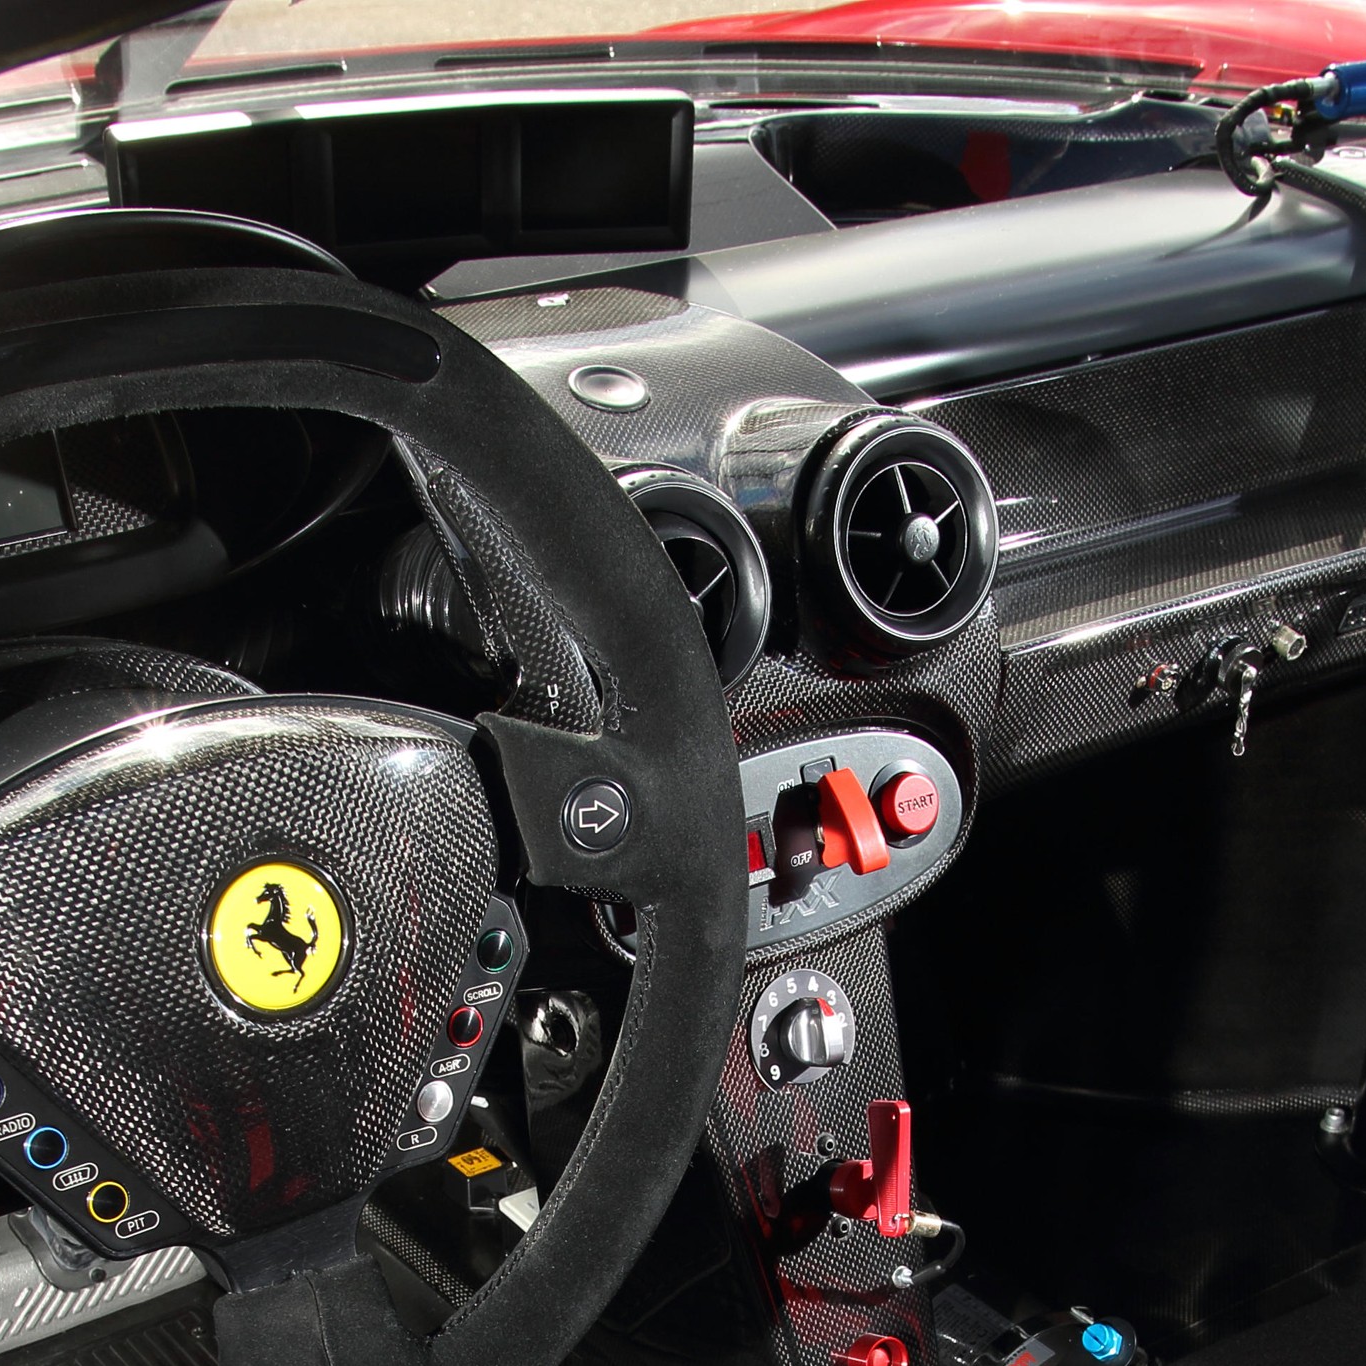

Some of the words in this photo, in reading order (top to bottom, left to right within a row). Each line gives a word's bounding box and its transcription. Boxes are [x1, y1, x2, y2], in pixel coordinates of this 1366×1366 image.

[547, 683, 560, 715] UP
[777, 778, 794, 793] ON
[898, 793, 934, 815] START
[791, 850, 812, 867] OFF
[786, 977, 797, 994] 5
[808, 976, 819, 992] 4
[467, 986, 500, 1002] SCROLL
[768, 992, 778, 1007] 6
[826, 990, 837, 1005] 3
[758, 1015, 768, 1032] 7
[760, 1042, 770, 1057] 8
[770, 1065, 781, 1081] 9
[411, 1135, 420, 1145] R
[127, 1217, 146, 1233] PIT
